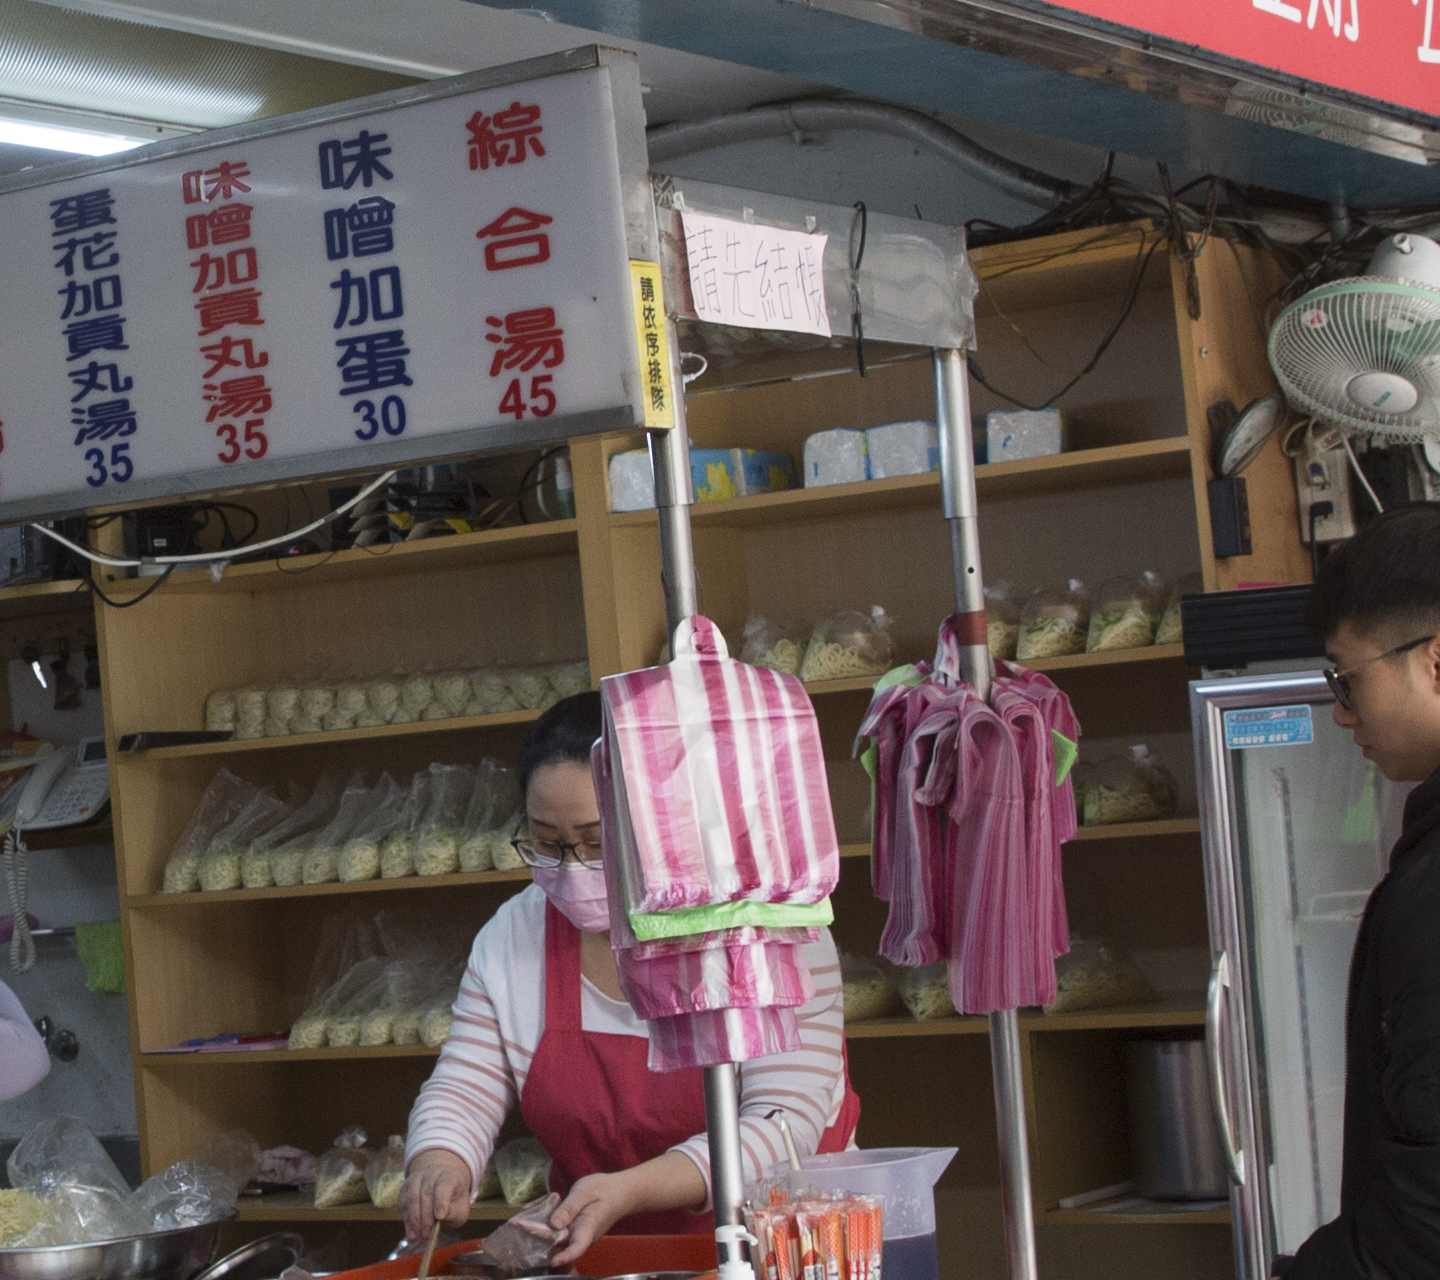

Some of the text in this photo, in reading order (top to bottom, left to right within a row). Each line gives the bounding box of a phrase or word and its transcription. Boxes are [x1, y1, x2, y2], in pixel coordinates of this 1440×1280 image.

[49, 188, 137, 487] 蛋花加貢丸湯 35
[182, 161, 272, 464] 味噌加貢丸湯 35
[319, 130, 413, 441] 味噌加蛋 30
[466, 102, 565, 421] 綜合湯 45
[640, 276, 666, 412] 請依序排隊
[684, 224, 826, 327] 請先結帳
